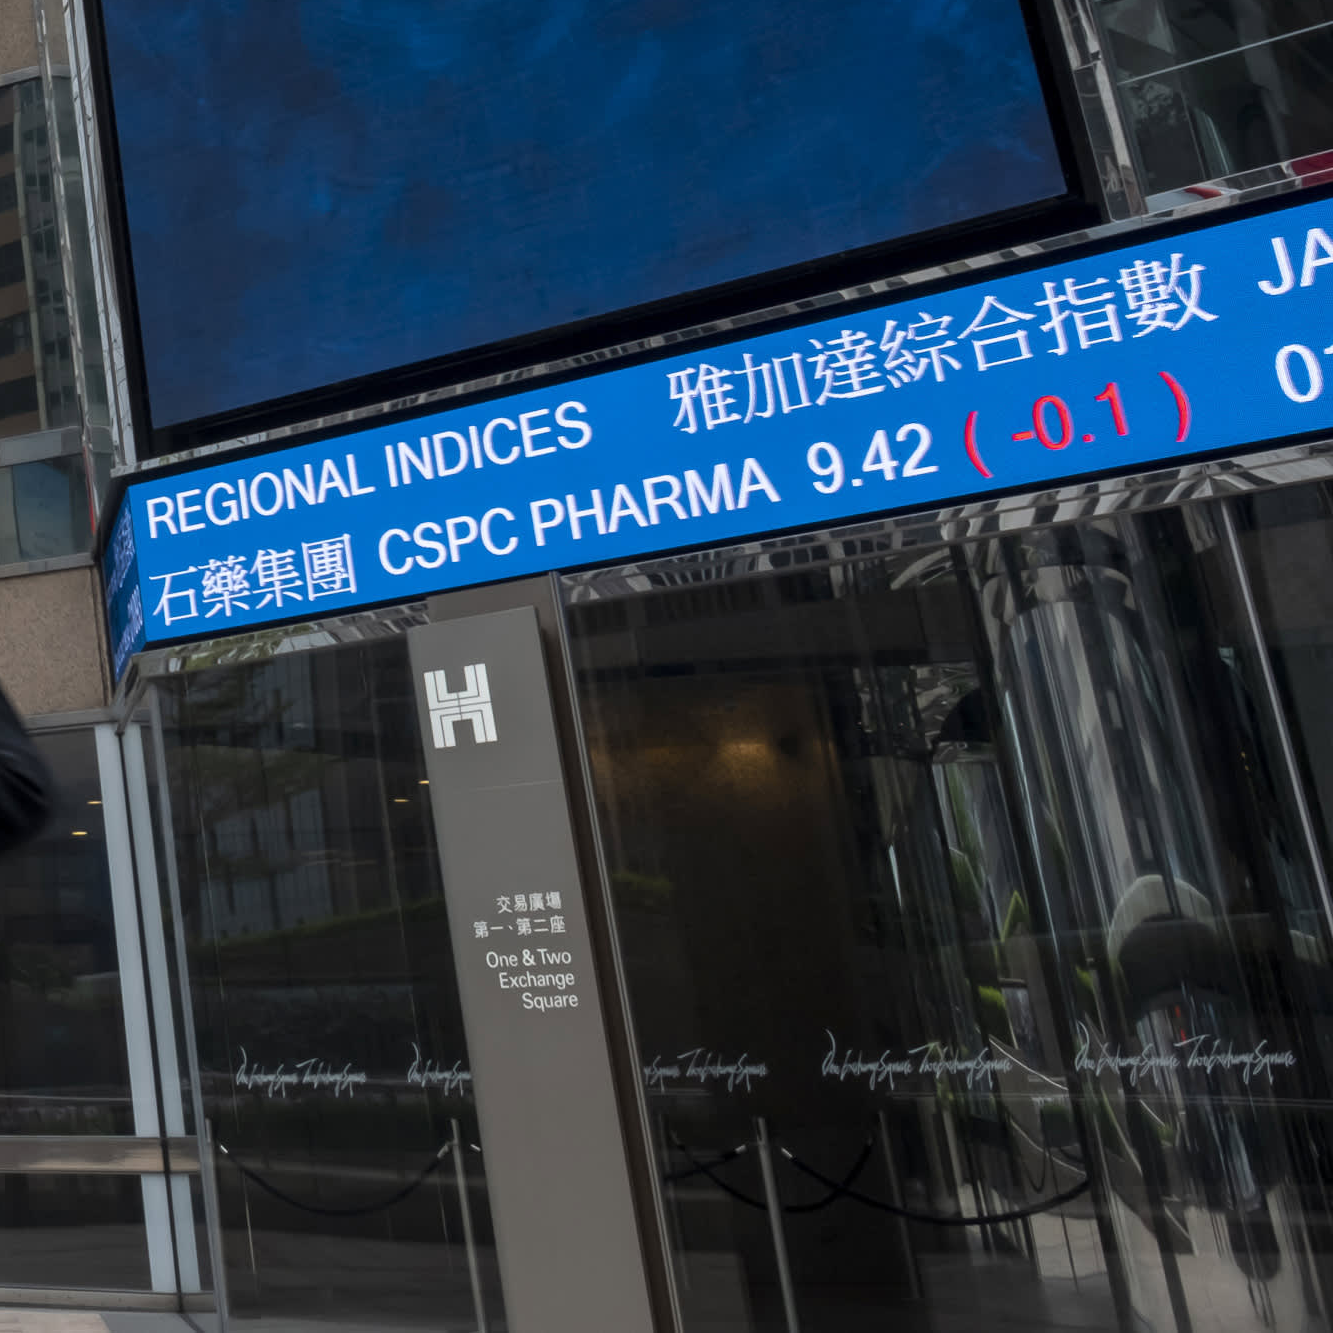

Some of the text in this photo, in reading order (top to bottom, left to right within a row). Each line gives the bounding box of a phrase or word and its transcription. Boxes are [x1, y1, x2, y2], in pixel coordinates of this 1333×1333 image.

[666, 252, 1219, 434] 雅加達綜合指數
[146, 400, 593, 539] REGIONAL INDICES
[378, 507, 519, 576] CSPC
[529, 457, 782, 547] PHARMA
[806, 422, 939, 494] 9.42
[148, 533, 358, 627] 石藥集團
[473, 915, 566, 938] 第一、第二座
[486, 948, 572, 968] One & Two
[499, 971, 575, 990] Exchange
[521, 992, 579, 1013] Square
